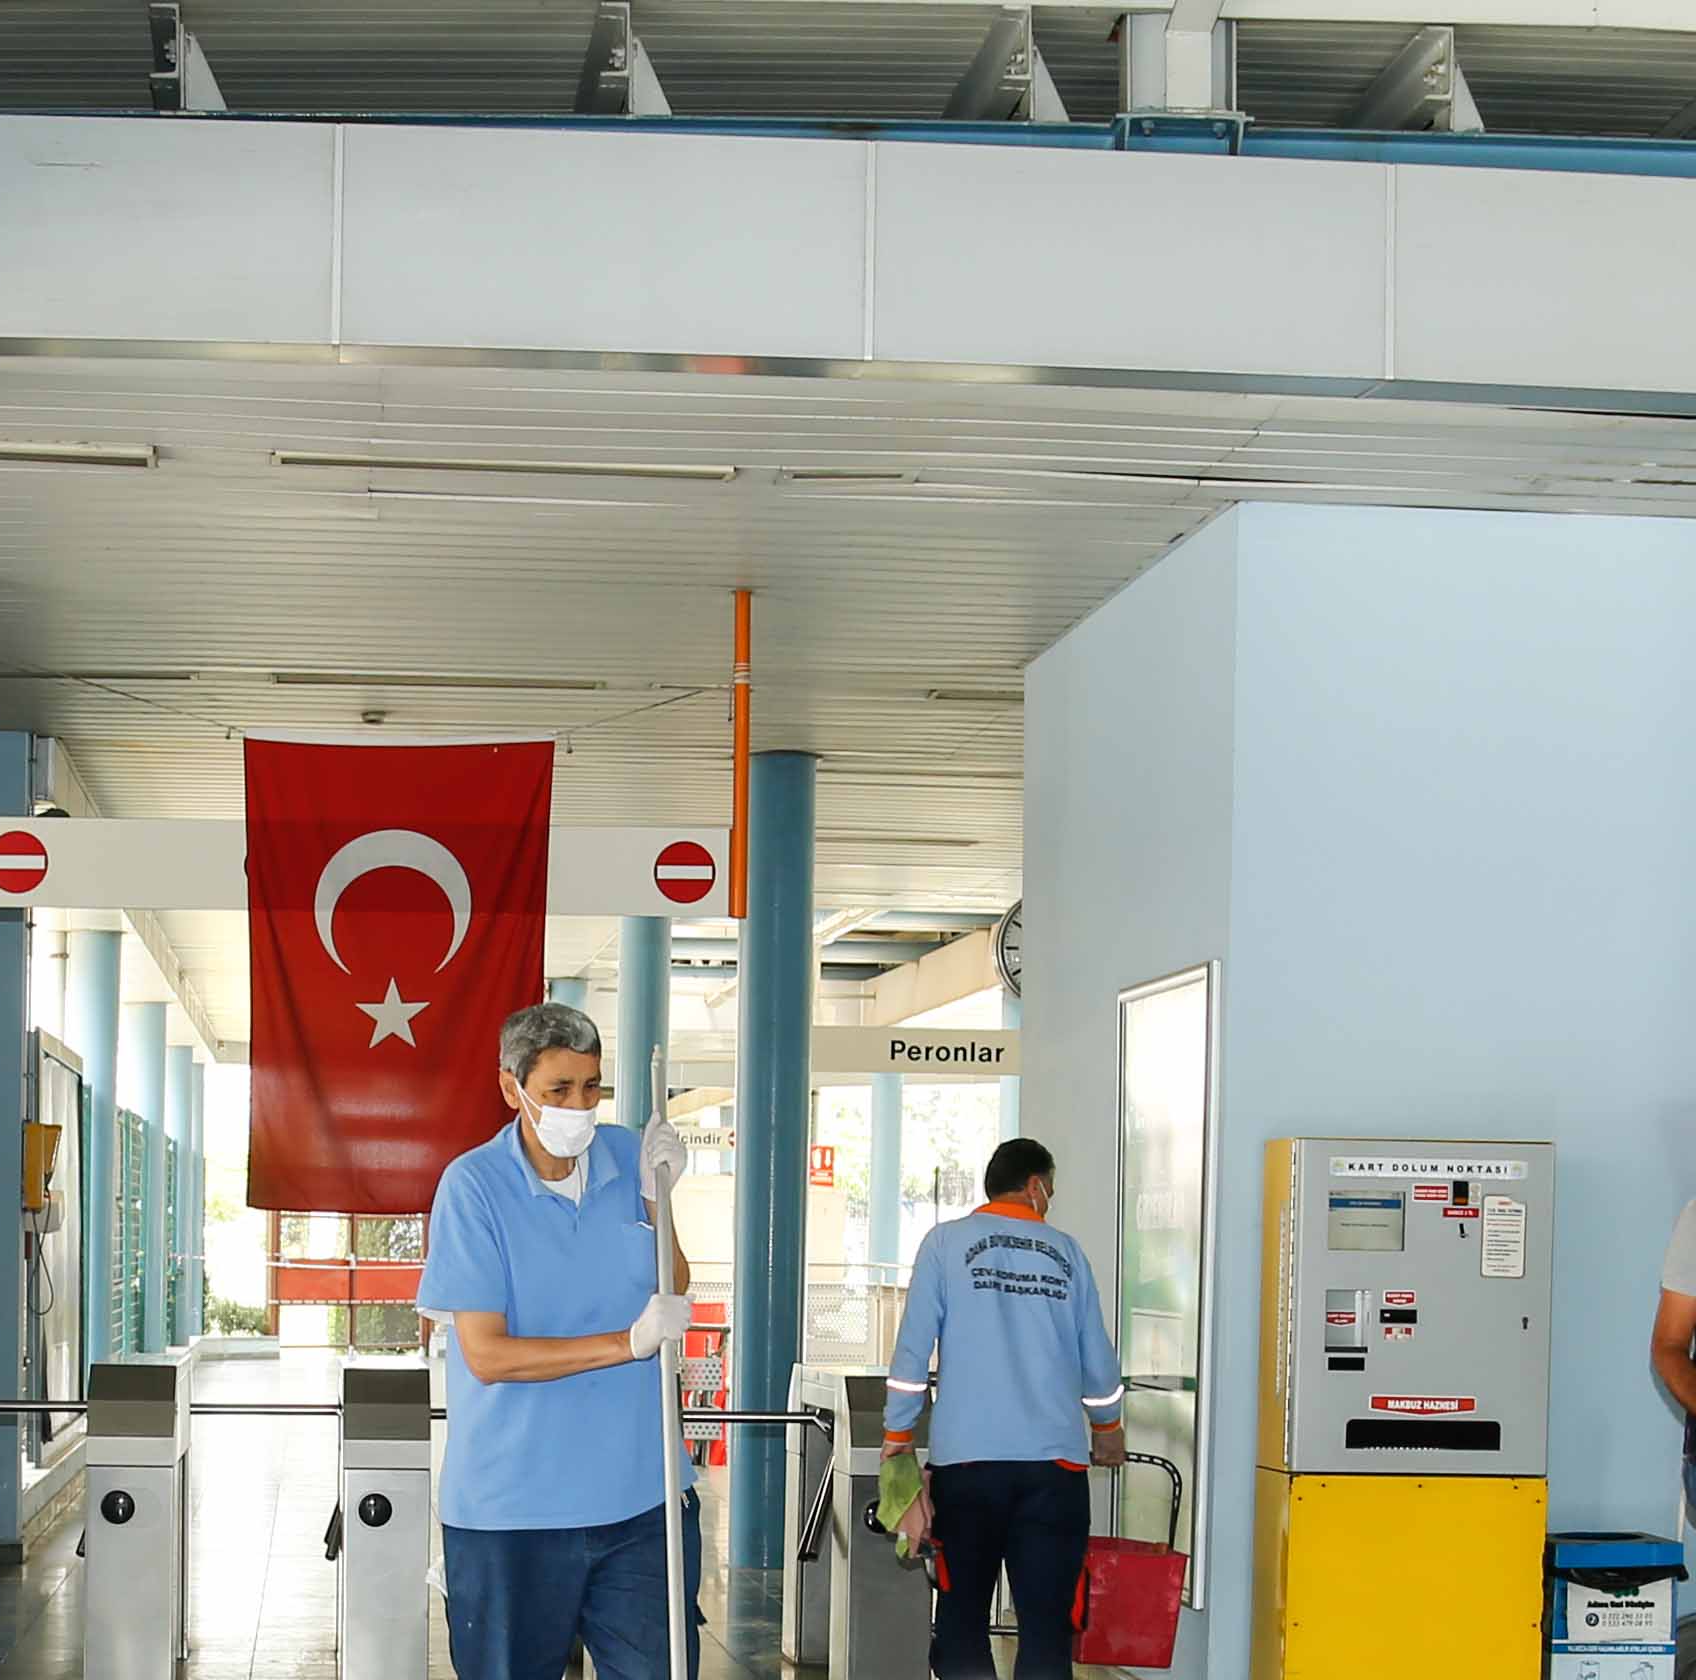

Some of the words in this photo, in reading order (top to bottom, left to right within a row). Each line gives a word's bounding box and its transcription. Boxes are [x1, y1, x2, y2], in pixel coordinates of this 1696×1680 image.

[890, 1039, 1005, 1062] Peronlar
[1348, 1163, 1384, 1172] KART
[1392, 1164, 1439, 1173] DOLUM
[1447, 1164, 1508, 1174] NOKTASI
